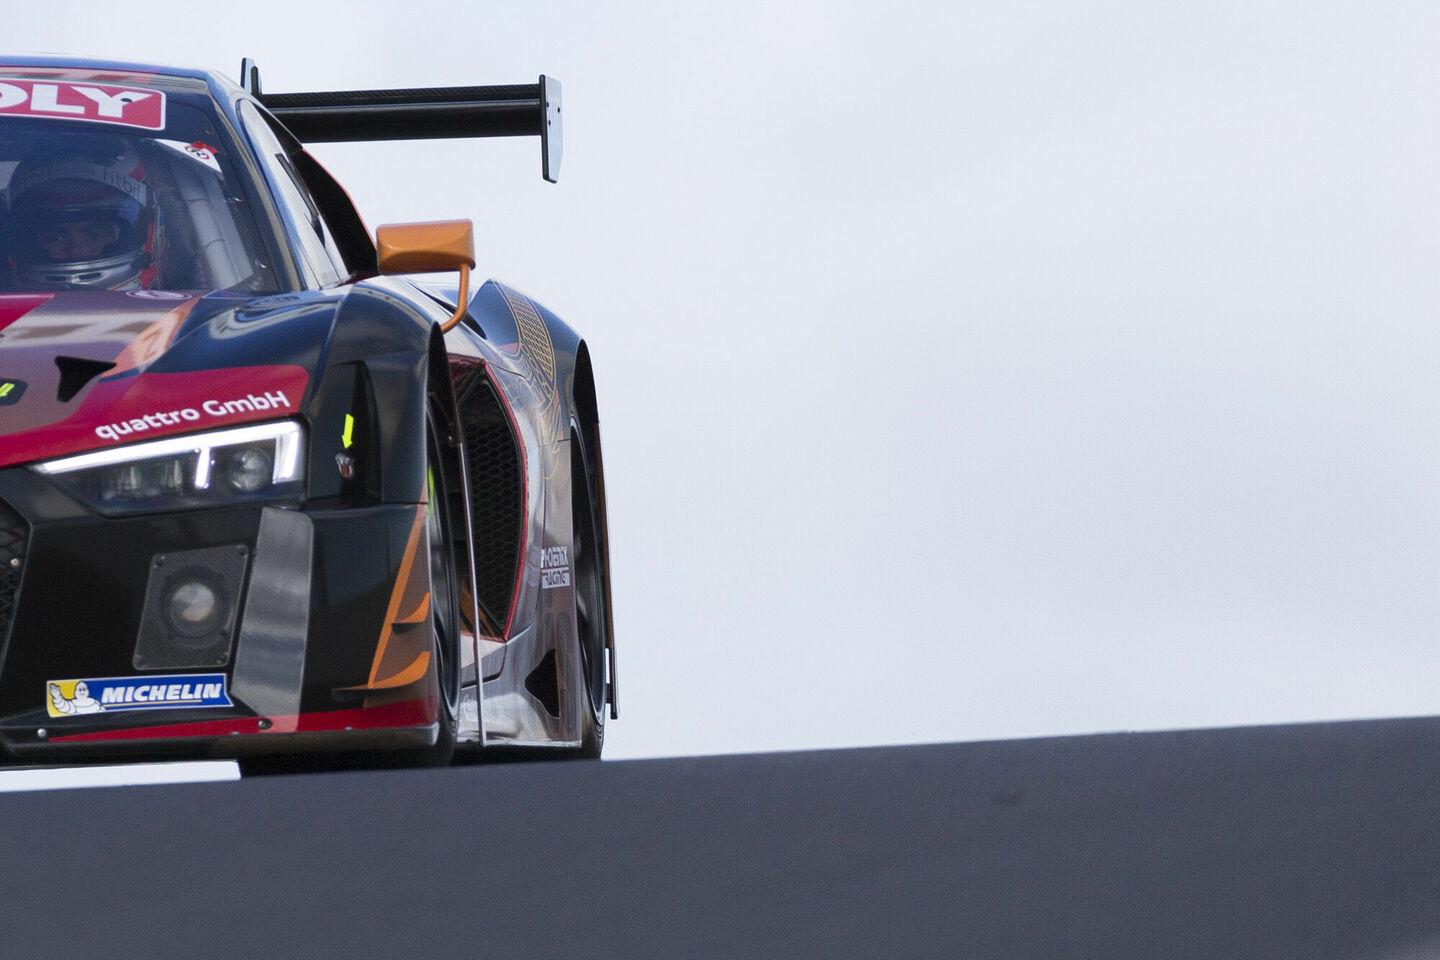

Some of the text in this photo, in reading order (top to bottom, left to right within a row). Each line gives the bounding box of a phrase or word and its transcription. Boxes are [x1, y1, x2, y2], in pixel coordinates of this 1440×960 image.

[95, 390, 290, 440] quattro GmbH
[101, 683, 222, 704] MICHELIN
